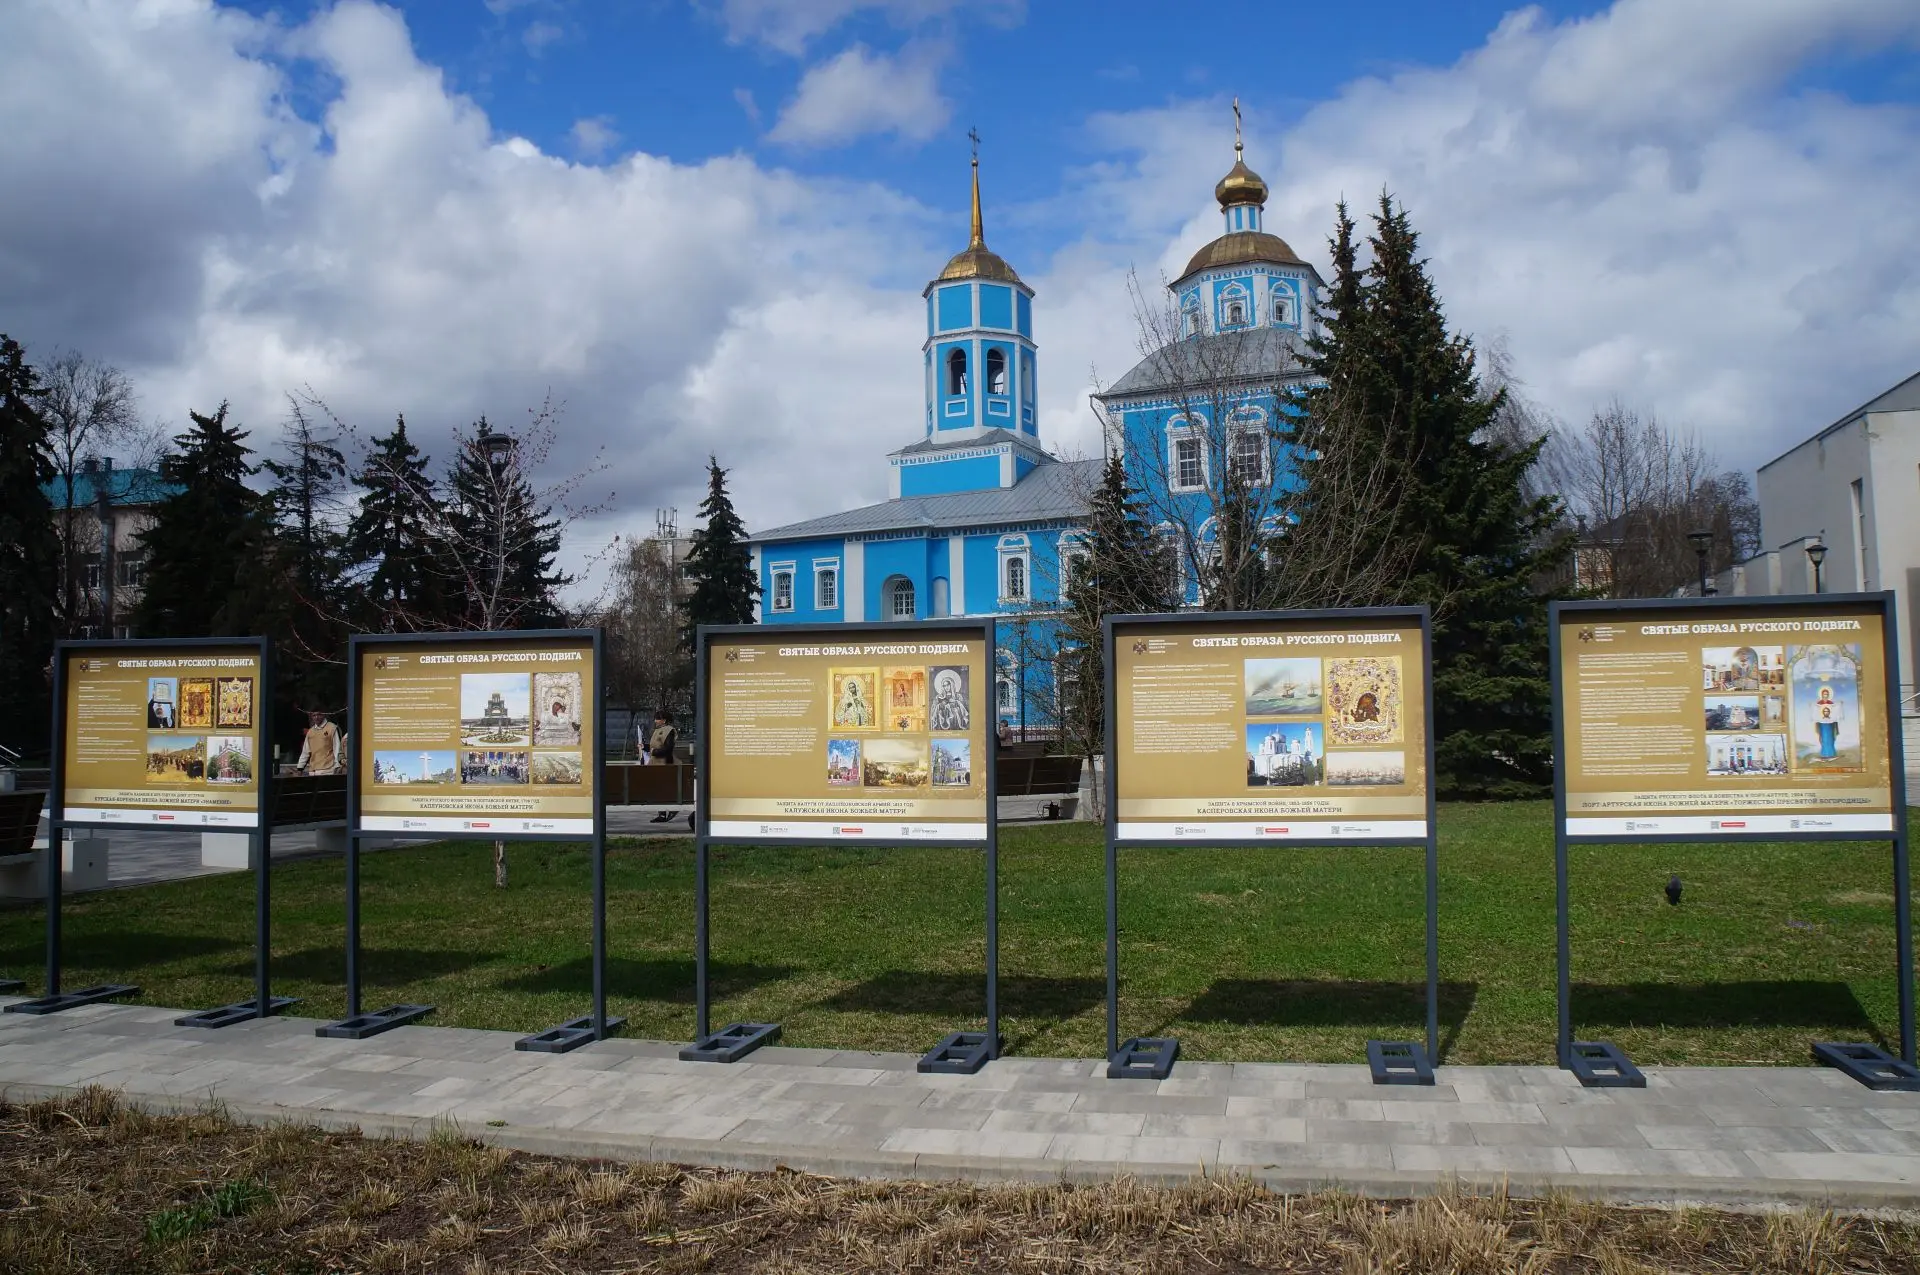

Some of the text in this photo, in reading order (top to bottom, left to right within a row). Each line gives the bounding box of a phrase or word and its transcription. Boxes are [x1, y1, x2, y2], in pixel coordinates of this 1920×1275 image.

[1641, 620, 1862, 635] СВЯТЫЕ ОБРАЗА РУССКОГО ПОДВИГА
[1192, 633, 1402, 647] СВЯТЫЕ ОБРАЗА РУССКОГО ПОДВИГА
[778, 647, 820, 656] СВЯТЫЕ
[822, 646, 861, 655] ОБРАЗА
[863, 645, 917, 655] РУССКОГО
[919, 644, 969, 655] ПОДВИГА
[117, 660, 148, 668] СВЯТЫЕ
[148, 659, 177, 667] ОБРАЗА
[178, 659, 217, 667] РУССКОГО
[217, 658, 255, 668] ПОДВИГА
[419, 655, 455, 664] СВЯТЫЕ
[456, 654, 490, 663] ОБРАЗА
[491, 653, 538, 662] РУССКОГО
[538, 652, 583, 662] ПОДВИГА
